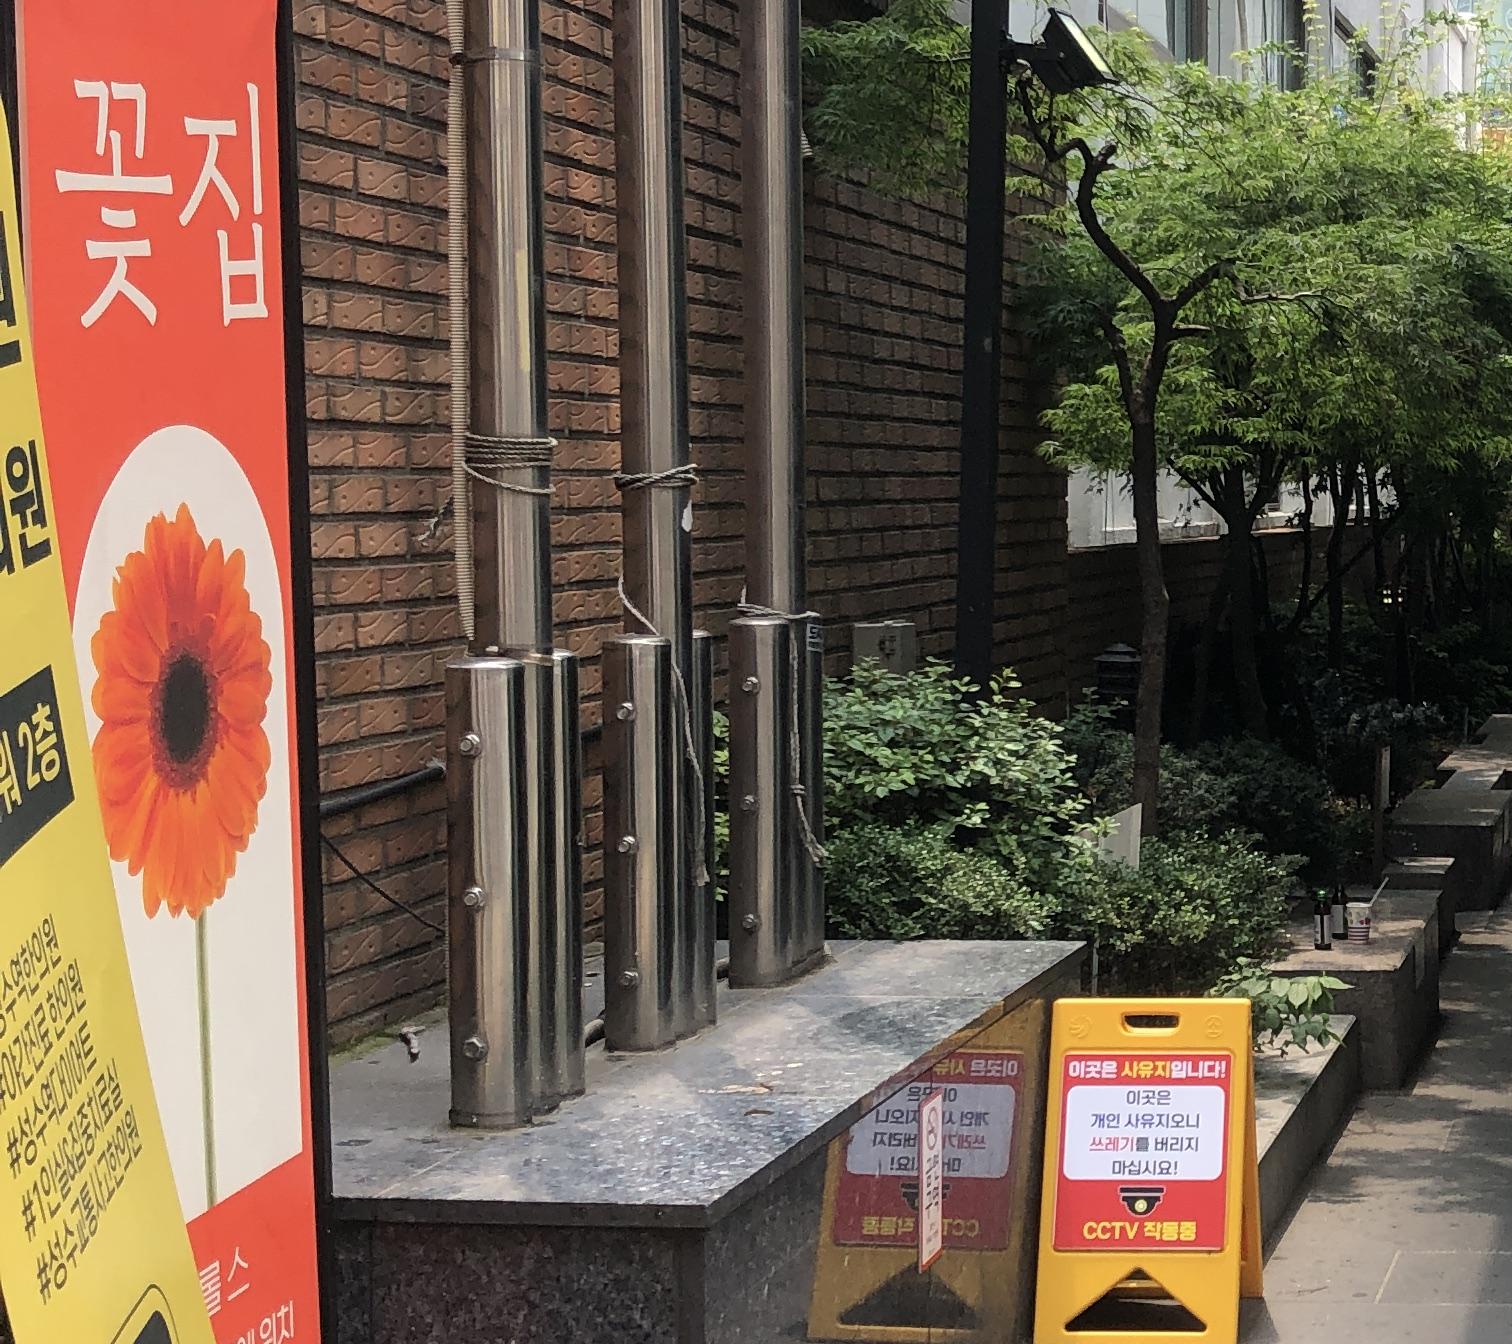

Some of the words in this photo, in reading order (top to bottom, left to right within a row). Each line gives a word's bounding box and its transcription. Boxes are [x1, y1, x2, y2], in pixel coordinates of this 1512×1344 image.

[55, 79, 268, 328] 꽃집
[46, 958, 87, 1041] 한의원
[1068, 1060, 1117, 1079] 이곳은
[1121, 1060, 1226, 1079] 사유지입니다!
[7, 1020, 97, 1179] #성수역다이어트
[1126, 1090, 1171, 1106] 이곳은
[1090, 1113, 1120, 1129] 개인
[1124, 1113, 1200, 1129] 사유지오니
[1089, 1136, 1149, 1152] 쓰레기를
[1154, 1136, 1199, 1152] 버리지
[1112, 1160, 1178, 1176] 마십시요!
[37, 1104, 142, 1305] #성수교통사고한의원
[1082, 1222, 1140, 1241] CCTV
[1143, 1221, 1197, 1241] 작동중
